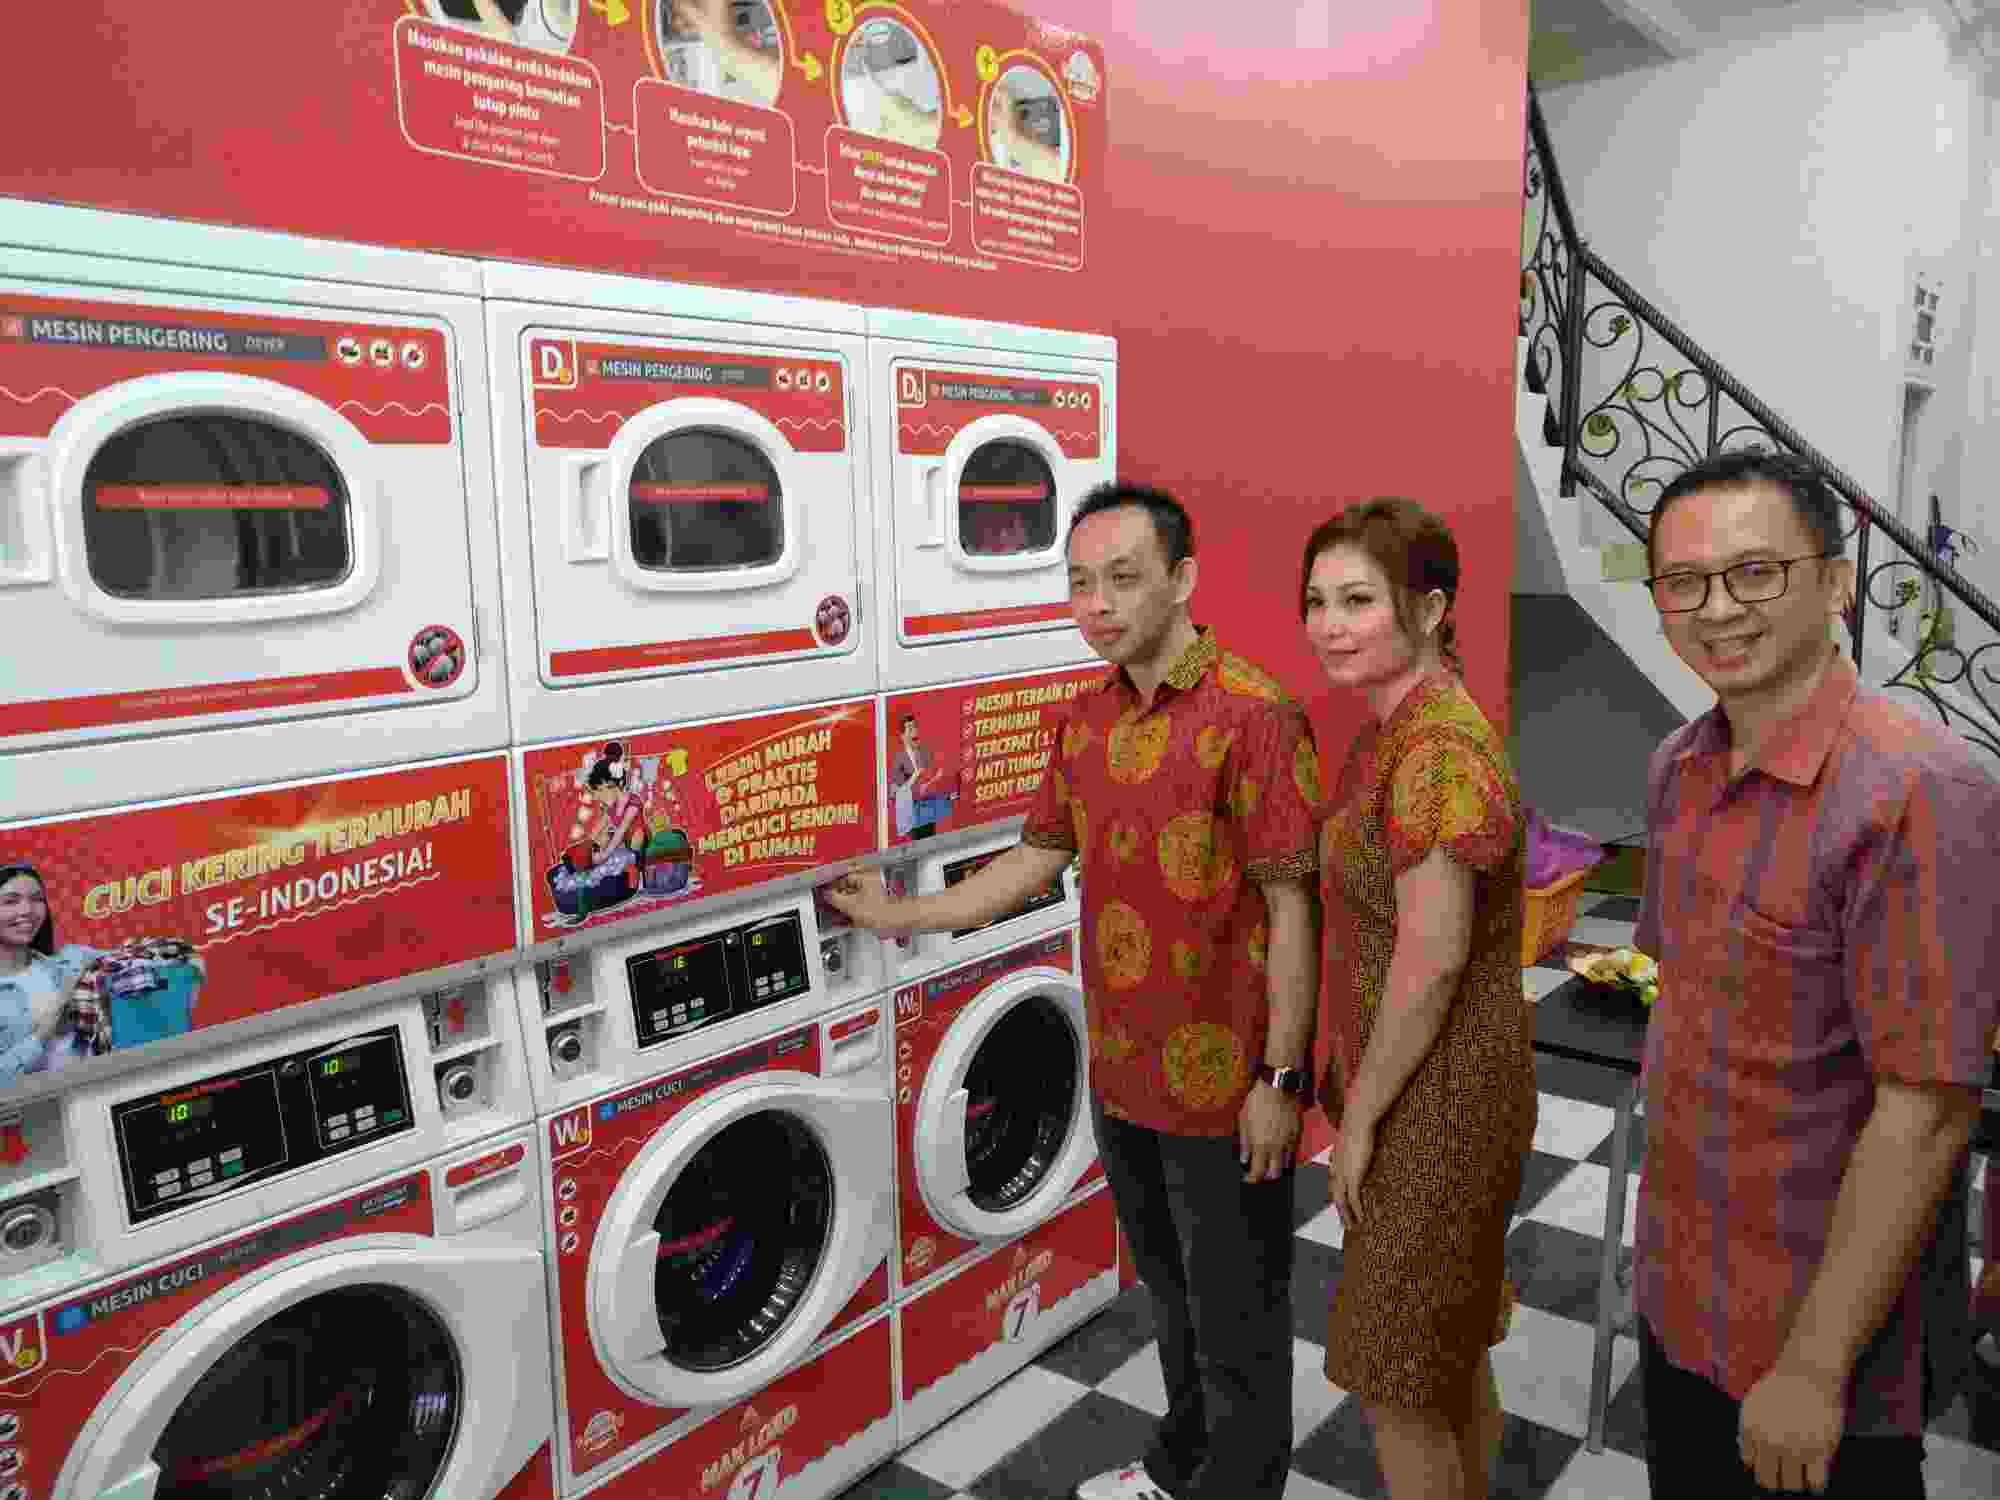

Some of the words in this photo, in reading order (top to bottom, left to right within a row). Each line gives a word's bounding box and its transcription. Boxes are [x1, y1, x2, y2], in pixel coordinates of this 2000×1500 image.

[31, 318, 105, 345] MESIN
[109, 323, 228, 352] PENGERING
[767, 729, 832, 763] MURAH
[82, 864, 173, 919] CUCI
[180, 837, 306, 894] KERING
[315, 787, 472, 857] TERMURAH
[205, 842, 434, 935] SE-INDONESIA!
[91, 1279, 154, 1319] MESIN
[157, 1264, 204, 1291] CUCI
